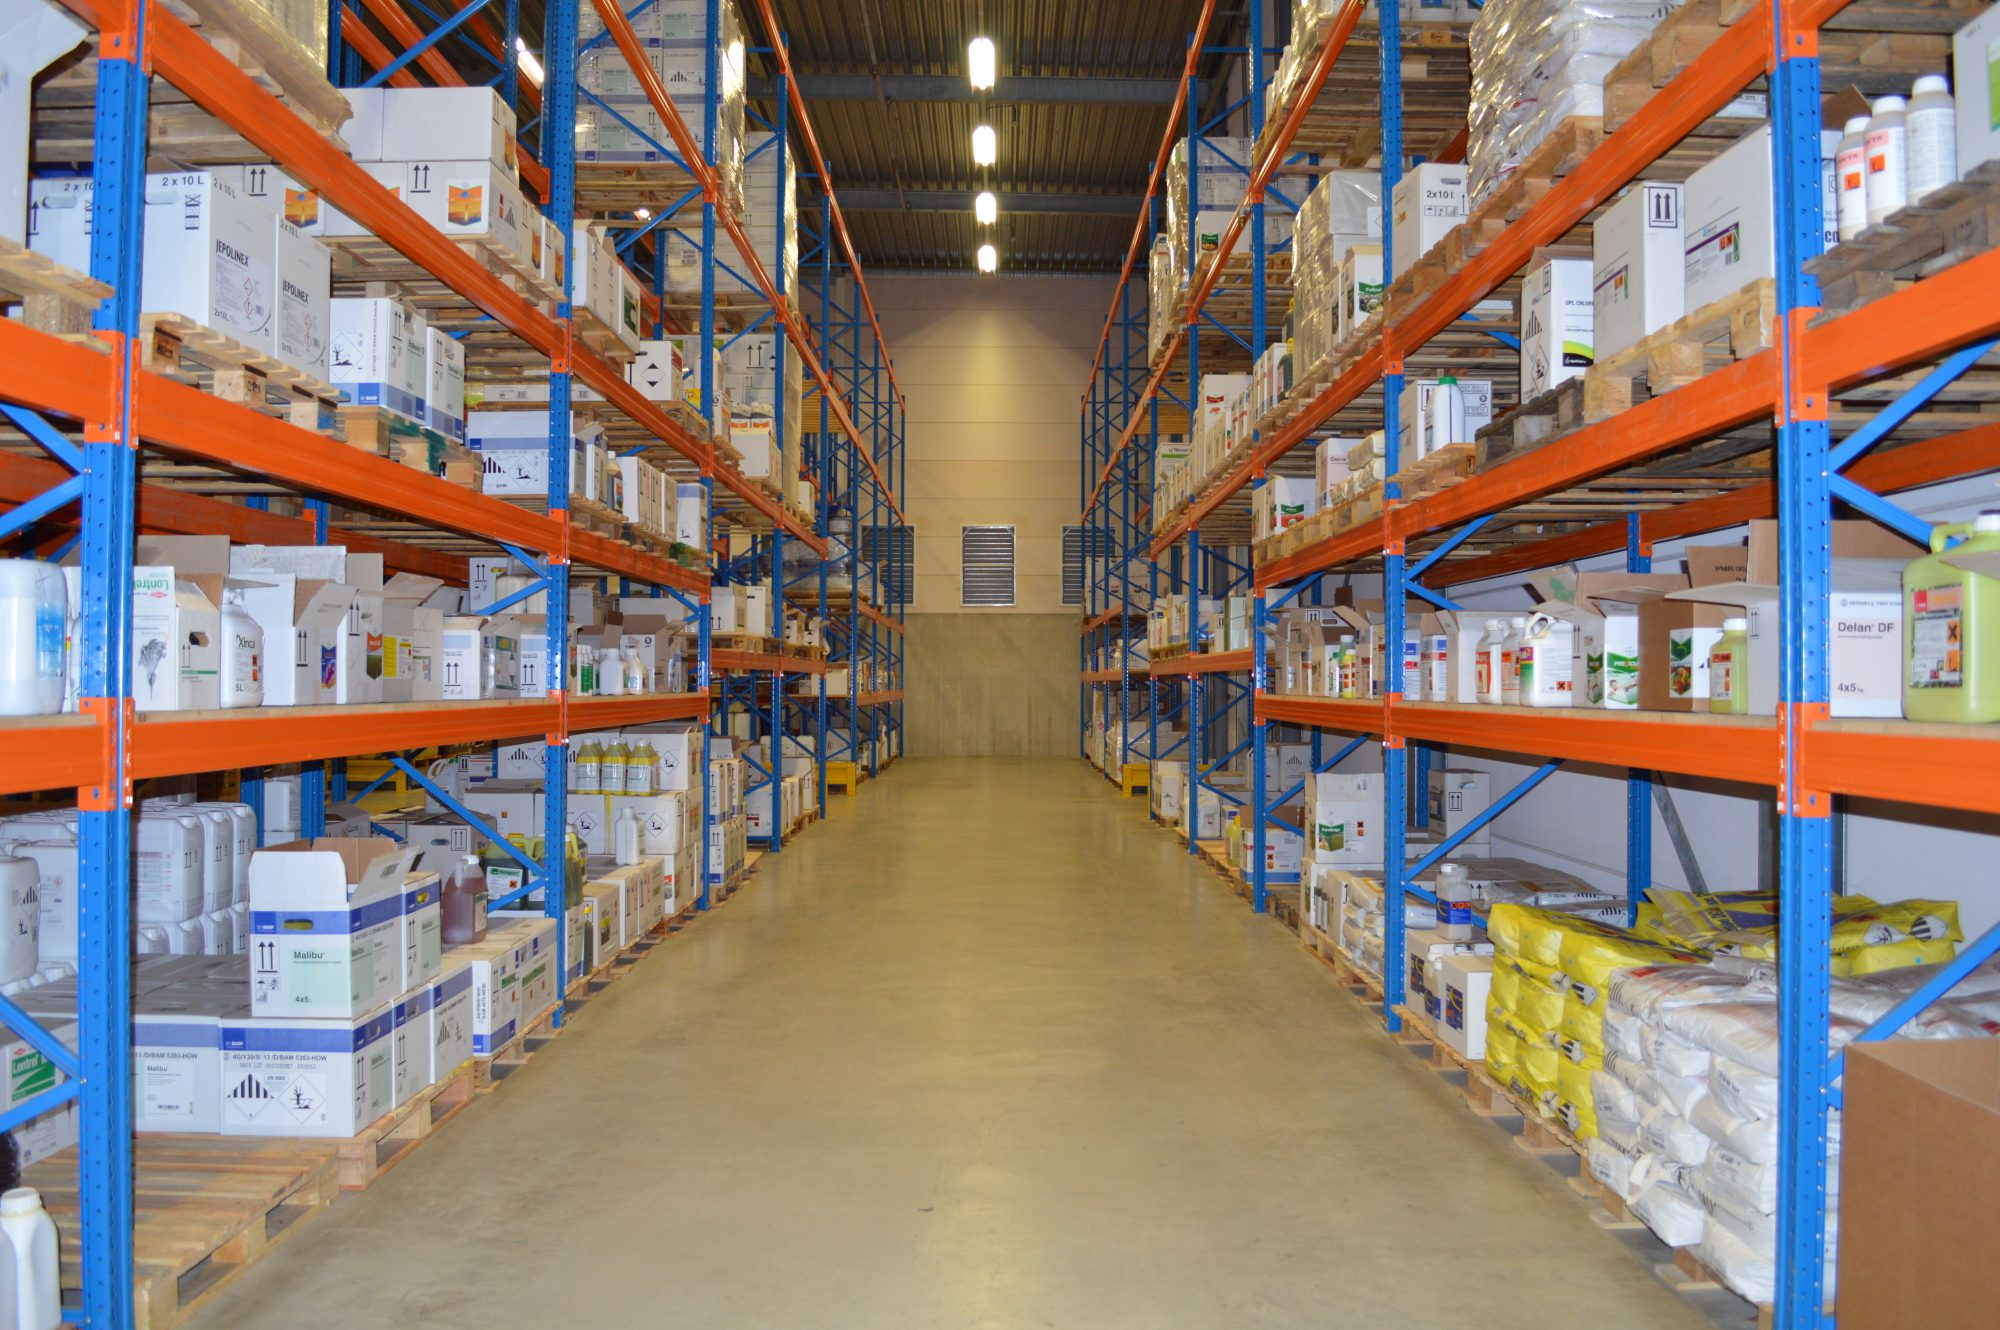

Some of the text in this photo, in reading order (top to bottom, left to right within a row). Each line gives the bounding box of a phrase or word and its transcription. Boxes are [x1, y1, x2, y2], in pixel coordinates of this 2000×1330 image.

[162, 177, 168, 186] 2
[183, 176, 194, 185] 10
[198, 175, 205, 184] L
[64, 183, 70, 192] 2
[213, 178, 218, 187] 2
[224, 185, 231, 196] 10
[1426, 190, 1447, 199] 2x10
[216, 239, 249, 268] JEPOLINEX
[283, 280, 309, 304] JEPOLINEX
[1837, 621, 1894, 633] Delan DF
[235, 683, 244, 692] 5L
[1837, 682, 1857, 693] 4x5
[293, 951, 323, 960] Malibu
[295, 995, 309, 1004] 4x5
